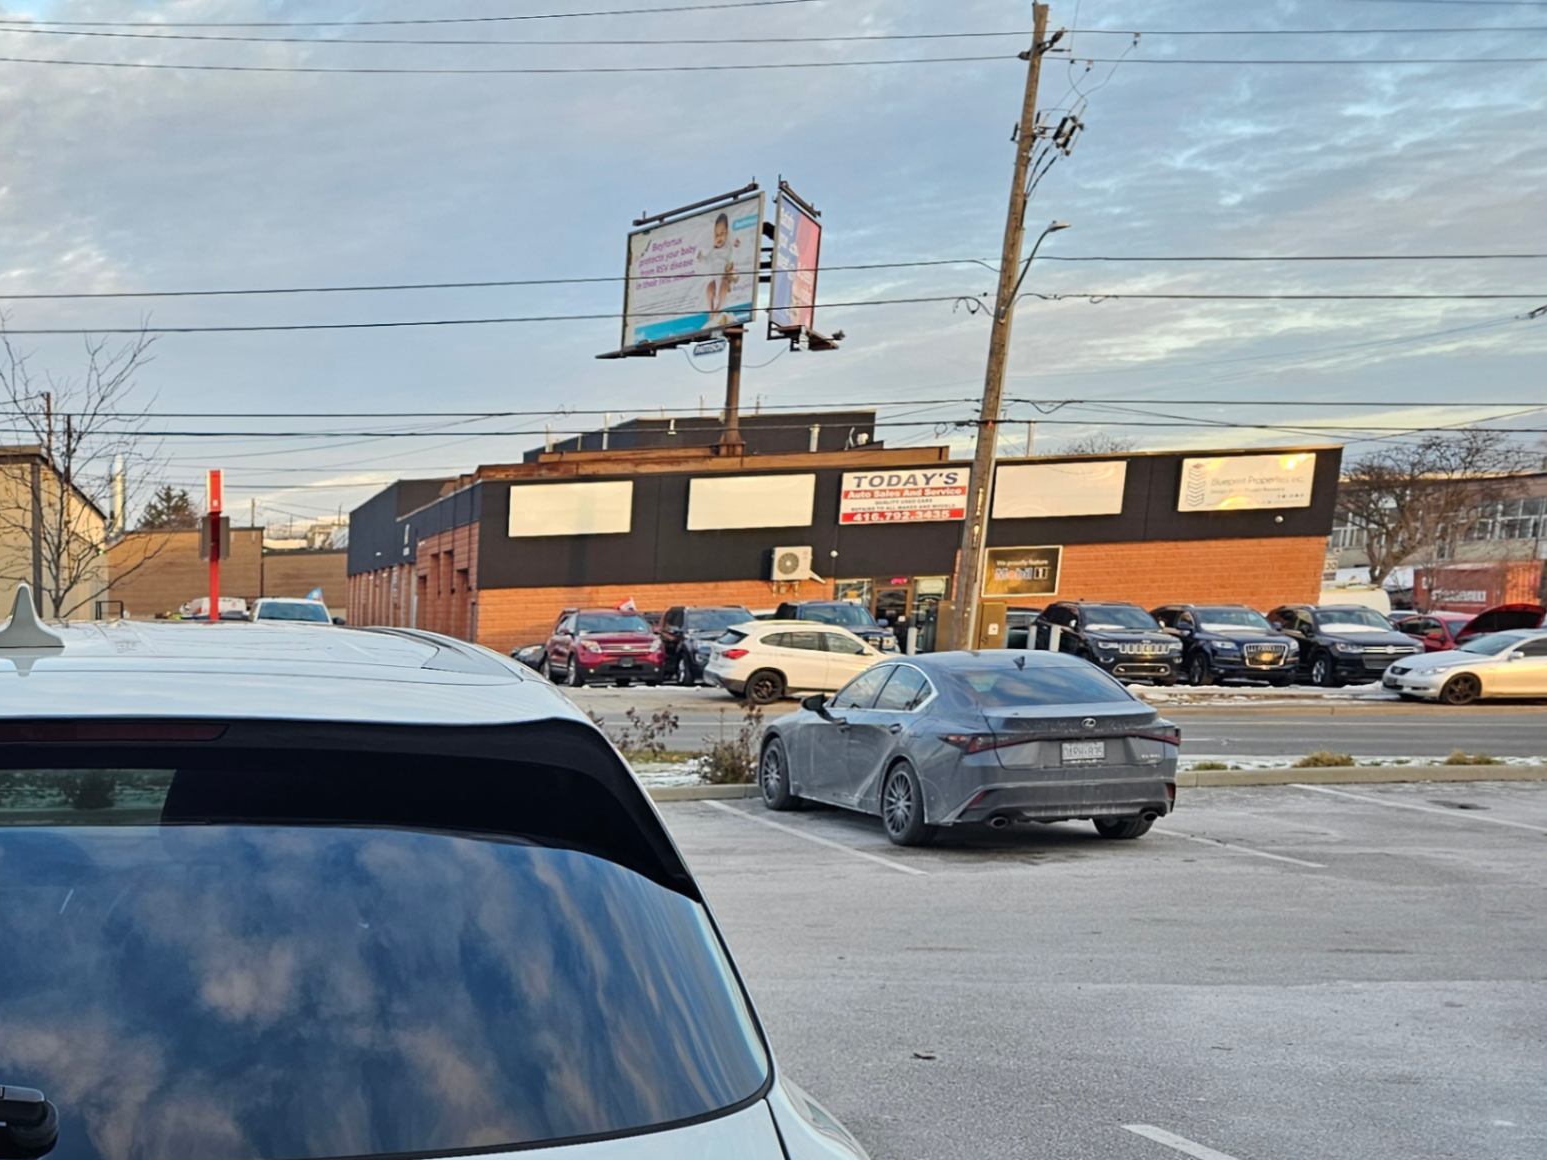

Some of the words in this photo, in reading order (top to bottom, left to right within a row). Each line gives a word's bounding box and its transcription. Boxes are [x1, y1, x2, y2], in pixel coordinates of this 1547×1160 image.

[853, 472, 959, 488] TODAY'S
[848, 491, 872, 499] Auto
[873, 489, 901, 498] Sales
[902, 488, 923, 497] And
[924, 486, 962, 496] Service
[853, 509, 951, 521] 416.792.3435
[995, 567, 1033, 580] Mobil
